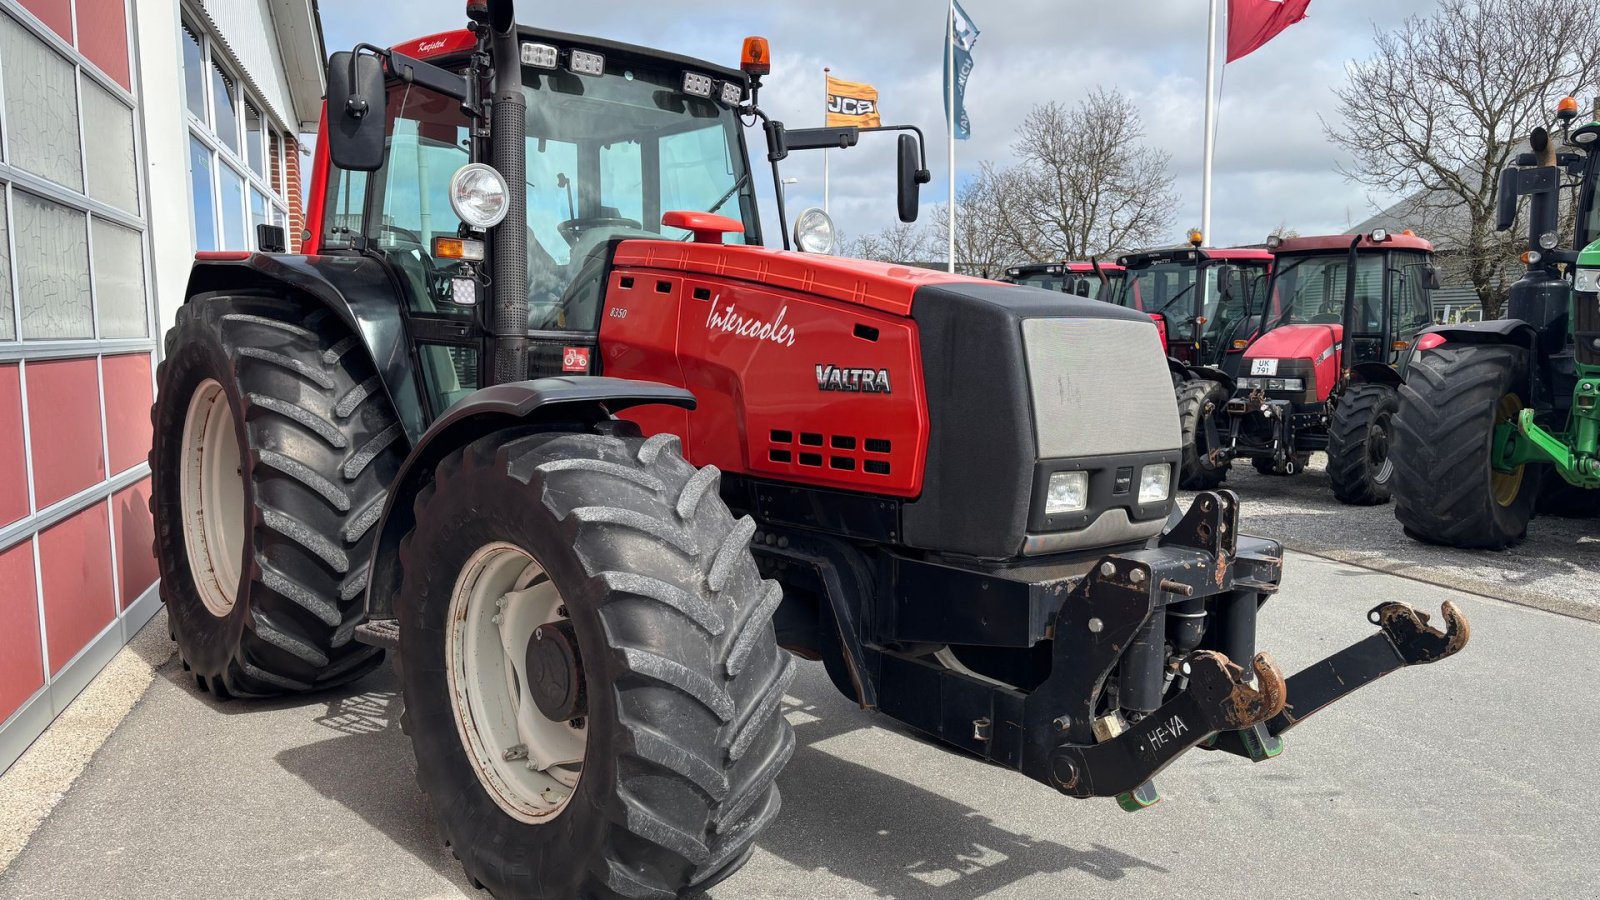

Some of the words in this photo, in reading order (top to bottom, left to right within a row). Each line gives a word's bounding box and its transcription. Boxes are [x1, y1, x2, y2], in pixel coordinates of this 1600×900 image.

[828, 96, 874, 115] JCB
[609, 307, 628, 318] 8350
[705, 294, 796, 347] Intercooler
[815, 364, 891, 394] VALTRA
[1256, 366, 1269, 374] 791
[1146, 714, 1189, 751] HE-VA
